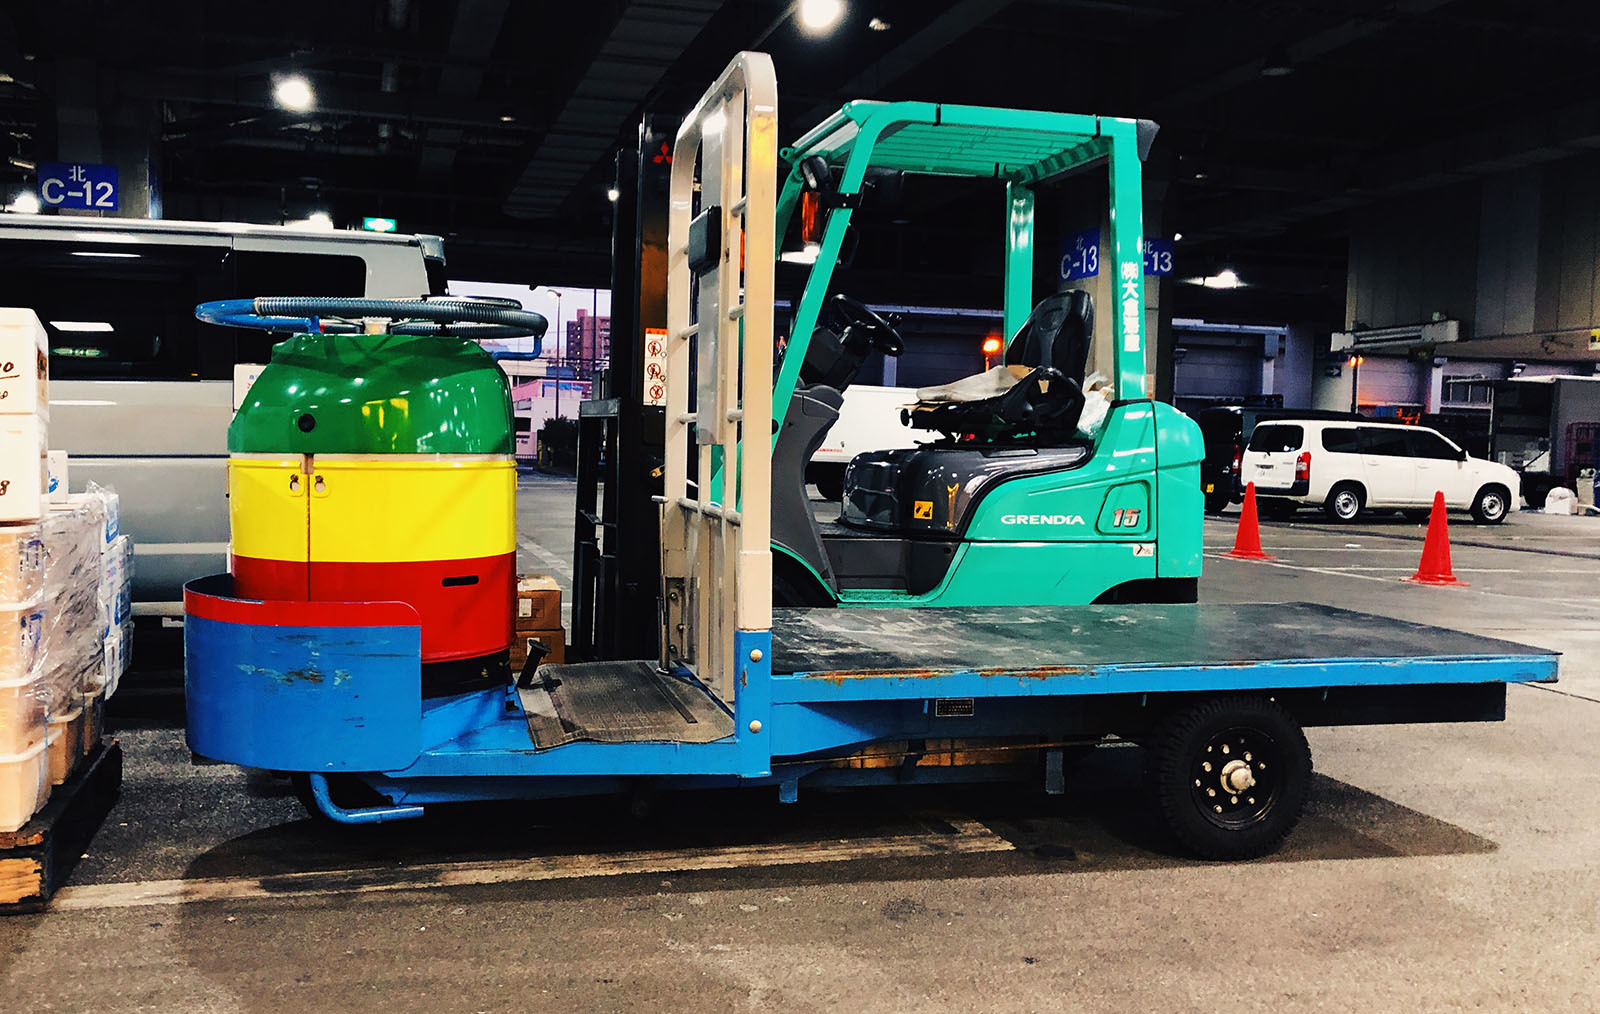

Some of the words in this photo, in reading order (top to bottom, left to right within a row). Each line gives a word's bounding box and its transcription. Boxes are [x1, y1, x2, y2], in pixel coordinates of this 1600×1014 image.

[68, 165, 86, 182] 北
[42, 178, 114, 208] C-12
[1061, 245, 1098, 279] C-13
[1001, 514, 1086, 525] GRENDIA
[1113, 508, 1141, 528] 15
